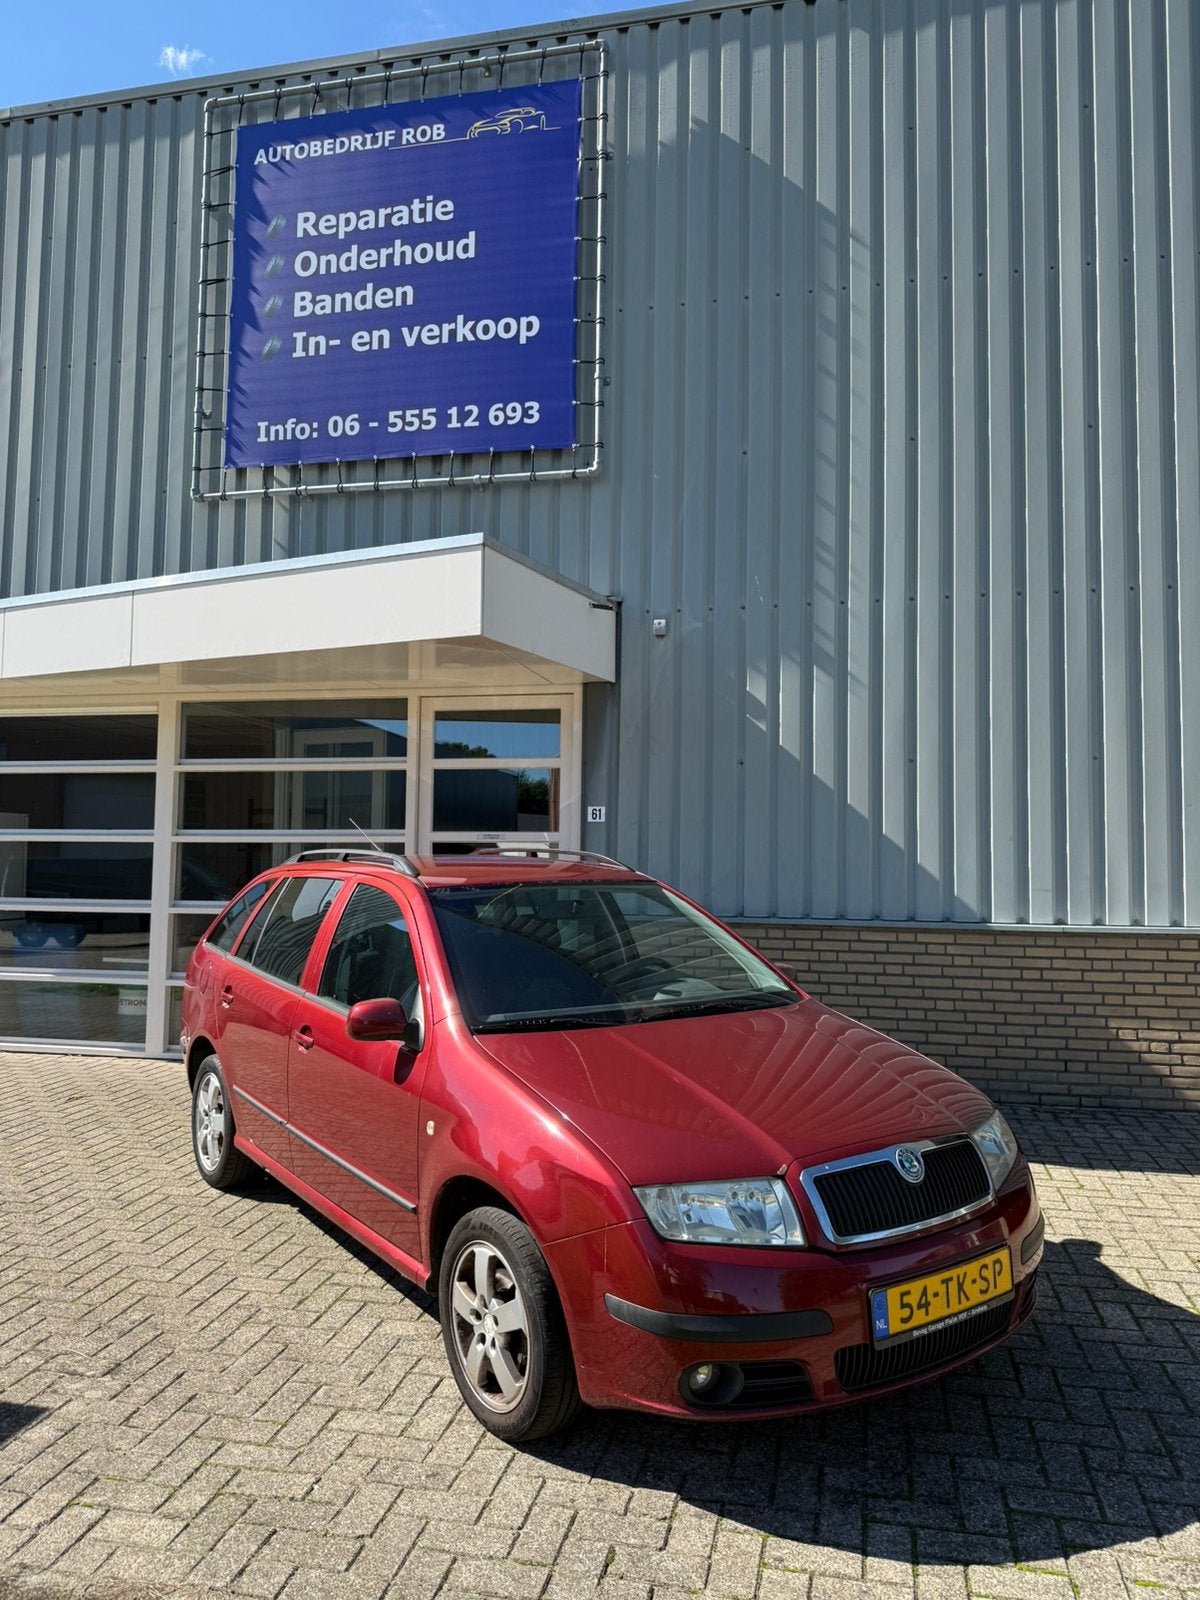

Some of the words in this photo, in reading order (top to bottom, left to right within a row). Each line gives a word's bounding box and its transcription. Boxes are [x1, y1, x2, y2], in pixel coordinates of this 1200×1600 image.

[254, 129, 396, 166] AUTOBEDRIJF
[401, 124, 446, 145] ROB
[296, 195, 455, 239] Reparatie
[294, 231, 476, 278] Onderhoud
[293, 283, 414, 318] Banden
[292, 331, 341, 358] In-
[351, 327, 390, 352] en
[401, 314, 540, 345] verkoop
[257, 419, 318, 442] Info:
[327, 414, 360, 436] 06
[387, 408, 436, 433] 555
[447, 405, 479, 428] 12
[488, 401, 540, 426] 693
[591, 808, 602, 820] 61
[900, 1258, 1004, 1325] 54-TK-SP
[875, 1318, 888, 1331] NL
